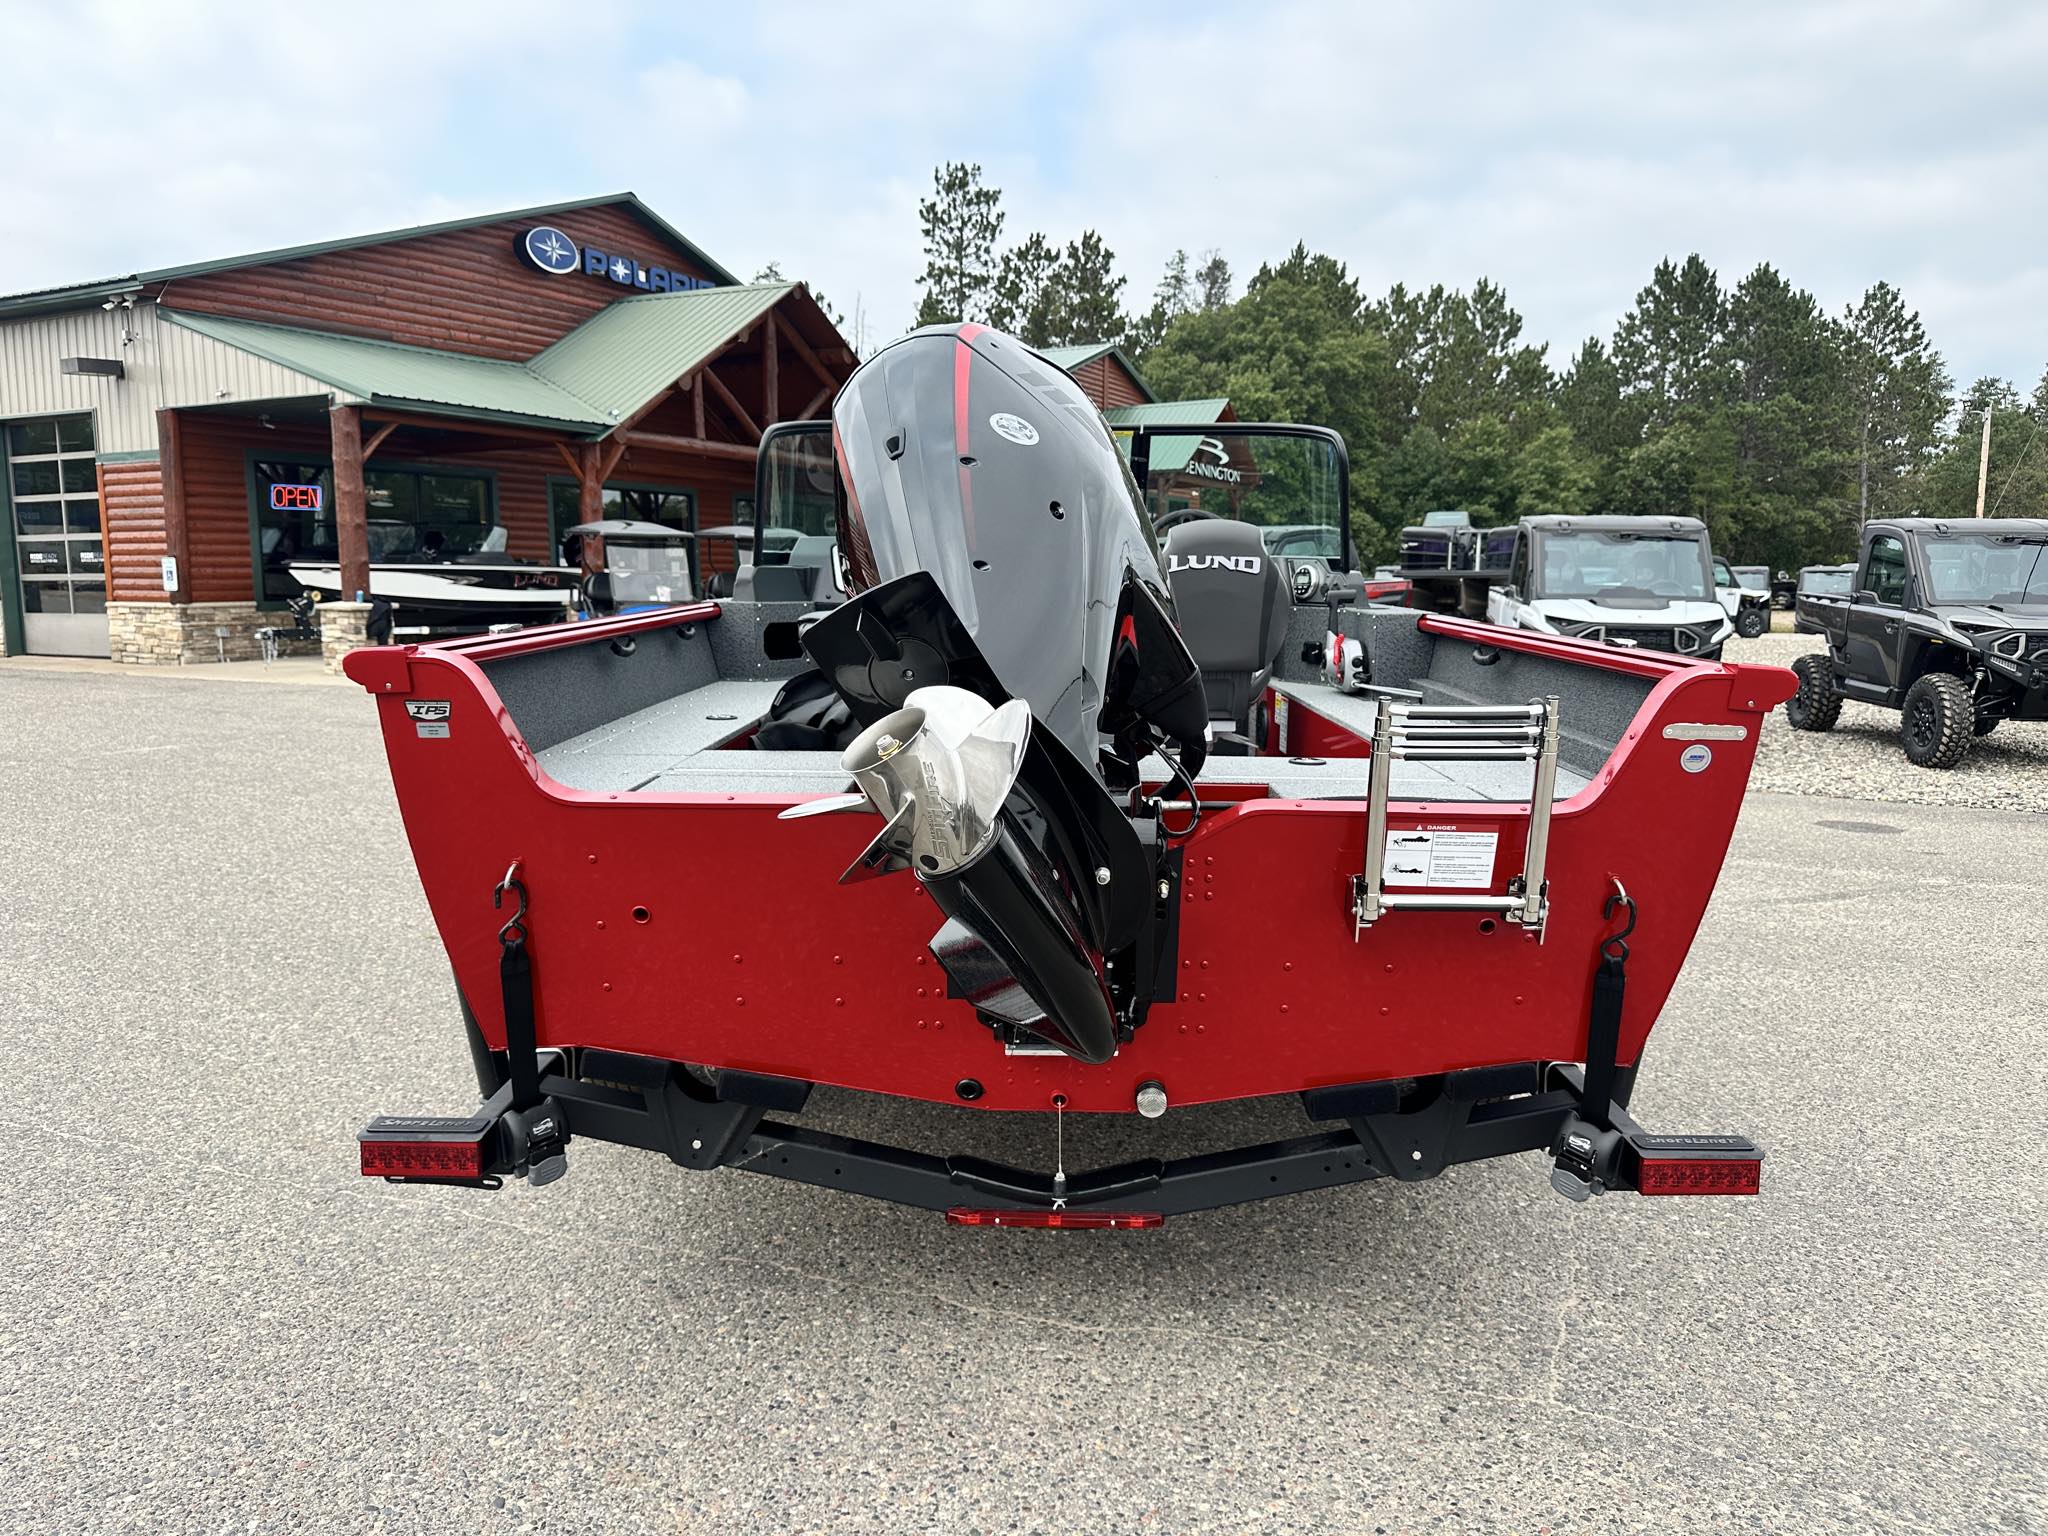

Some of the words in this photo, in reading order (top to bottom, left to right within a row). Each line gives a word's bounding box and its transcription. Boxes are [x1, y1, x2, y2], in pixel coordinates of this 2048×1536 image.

[273, 486, 319, 508] OPEN
[1169, 555, 1260, 574] LUND
[412, 705, 449, 715] IPS
